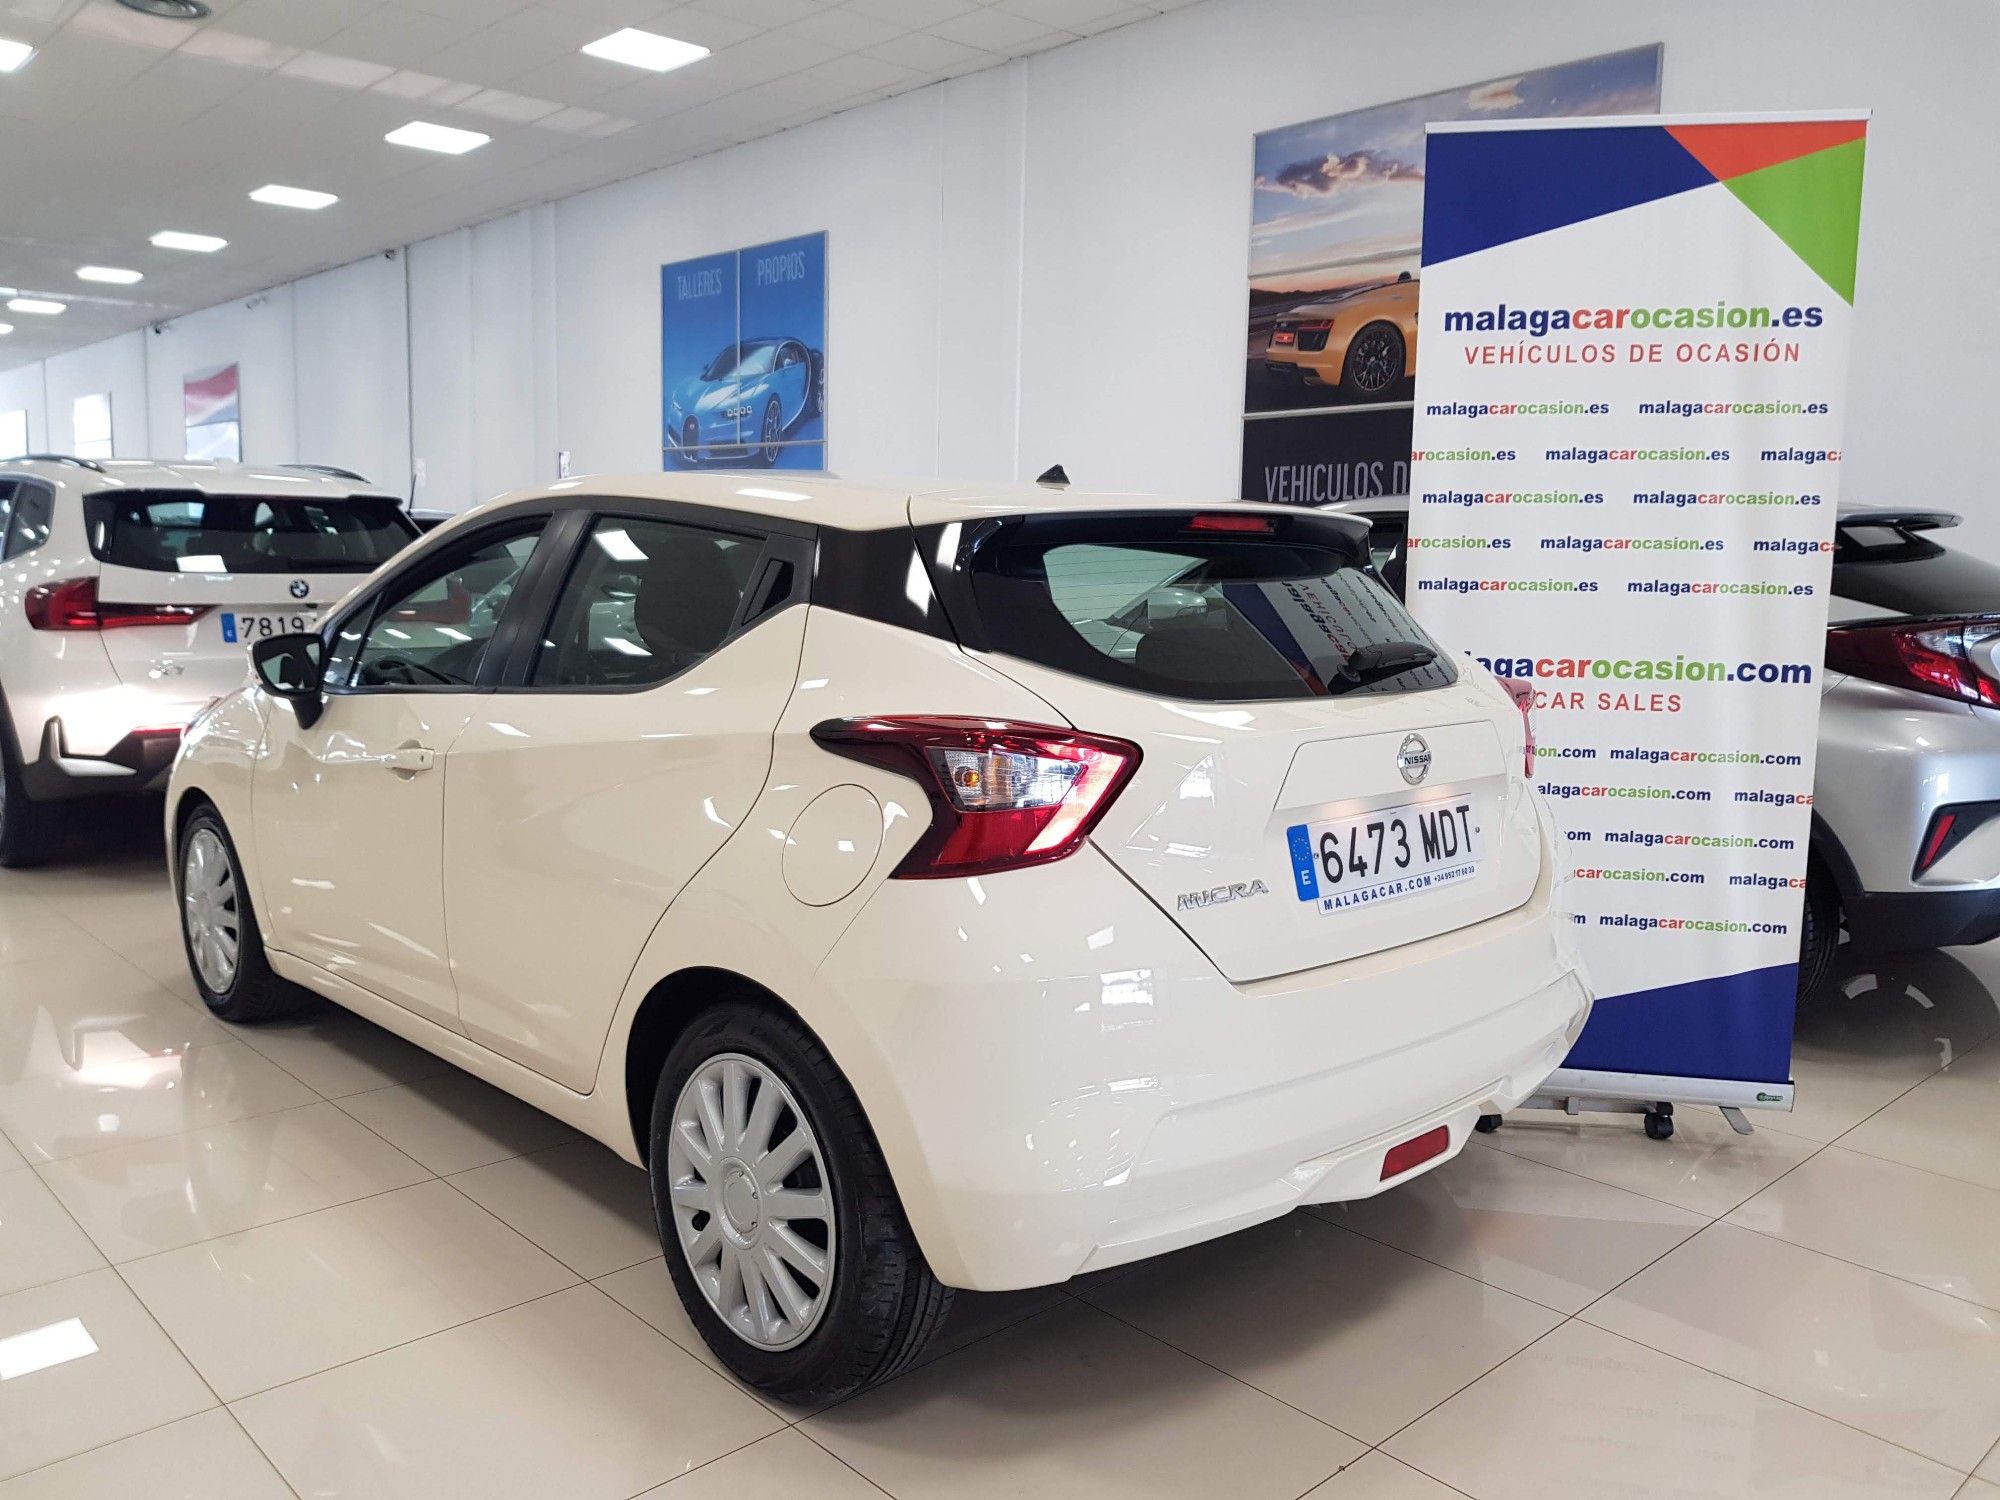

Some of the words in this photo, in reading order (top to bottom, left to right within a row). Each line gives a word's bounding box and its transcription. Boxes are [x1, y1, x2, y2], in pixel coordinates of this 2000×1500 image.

[677, 267, 722, 301] TALLERES
[757, 250, 806, 287] PROPIOS
[1444, 301, 1823, 337] malagacarocasion.es
[1464, 339, 1616, 365] VEHÍCULOS
[1629, 343, 1663, 363] DE
[1676, 337, 1800, 363] OCASIÓN
[1426, 401, 1610, 418] malagacarocasion.es
[1638, 400, 1828, 417] malagacarocasion.es
[1545, 447, 1730, 464] malagacarocasion.es
[1264, 460, 1384, 503] VEHICULOS
[1422, 490, 1604, 507] malagacarocasion.es
[1633, 490, 1821, 508] malagacarocasion.es
[1540, 535, 1724, 552] malagacarocasion.es
[1418, 577, 1599, 594] malagacarocasion.es
[1627, 579, 1814, 597] malagacarocasion.es
[242, 616, 305, 638] 7819
[1464, 651, 1812, 684] agacarocasion.com
[1535, 691, 1585, 709] CAR
[1597, 692, 1682, 712] SALES
[1404, 753, 1431, 765] NISSAN
[1610, 748, 1801, 765] malagacarocasion.com
[1300, 869, 1312, 886] E
[1320, 817, 1412, 884] 6473
[1419, 804, 1472, 863] MDT
[1604, 831, 1795, 849] malagacarocasion.com
[1574, 868, 1705, 883] carocasion.com
[1177, 878, 1270, 912] MICRA
[1323, 875, 1432, 911] MALAGACAR.COM
[1599, 914, 1788, 934] malagacarocasion.com
